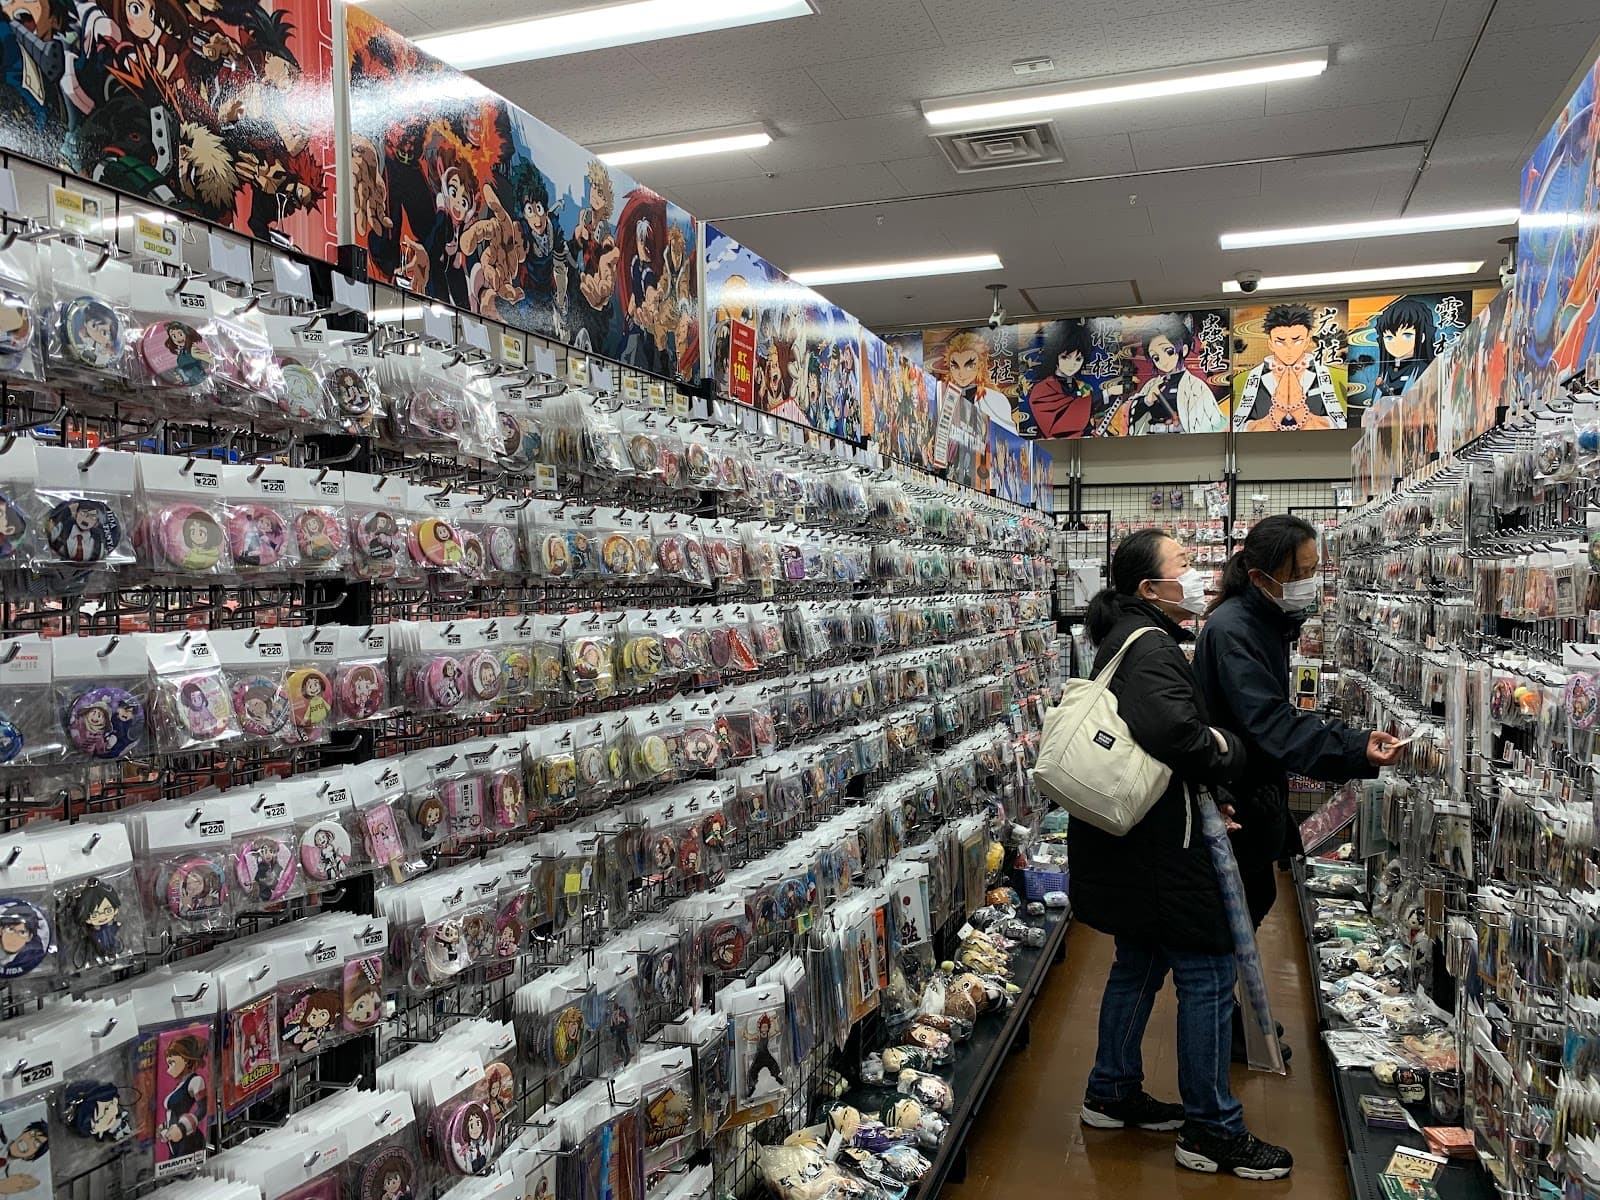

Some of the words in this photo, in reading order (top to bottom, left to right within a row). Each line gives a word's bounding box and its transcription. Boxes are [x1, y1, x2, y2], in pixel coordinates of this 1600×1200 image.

[182, 297, 205, 307] ¥330
[304, 333, 322, 342] ¥220
[1313, 307, 1344, 367] 岩柱
[990, 325, 1015, 384] 炎柱
[1090, 322, 1121, 379] 水柱
[195, 477, 217, 487] ¥220
[263, 483, 284, 492] ¥220
[321, 485, 338, 494] ¥220
[368, 639, 384, 648] ¥220
[261, 647, 282, 656] ¥220
[315, 644, 334, 654] ¥220
[384, 777, 399, 787] ¥220
[330, 793, 346, 802] ¥220
[265, 807, 285, 816] ¥220
[201, 824, 224, 834] ¥220
[365, 934, 382, 944] ¥220
[317, 949, 336, 961] ¥220
[23, 1066, 52, 1083] ¥220
[158, 1157, 193, 1171] URAVITY
[1396, 1153, 1437, 1167] WANTED
